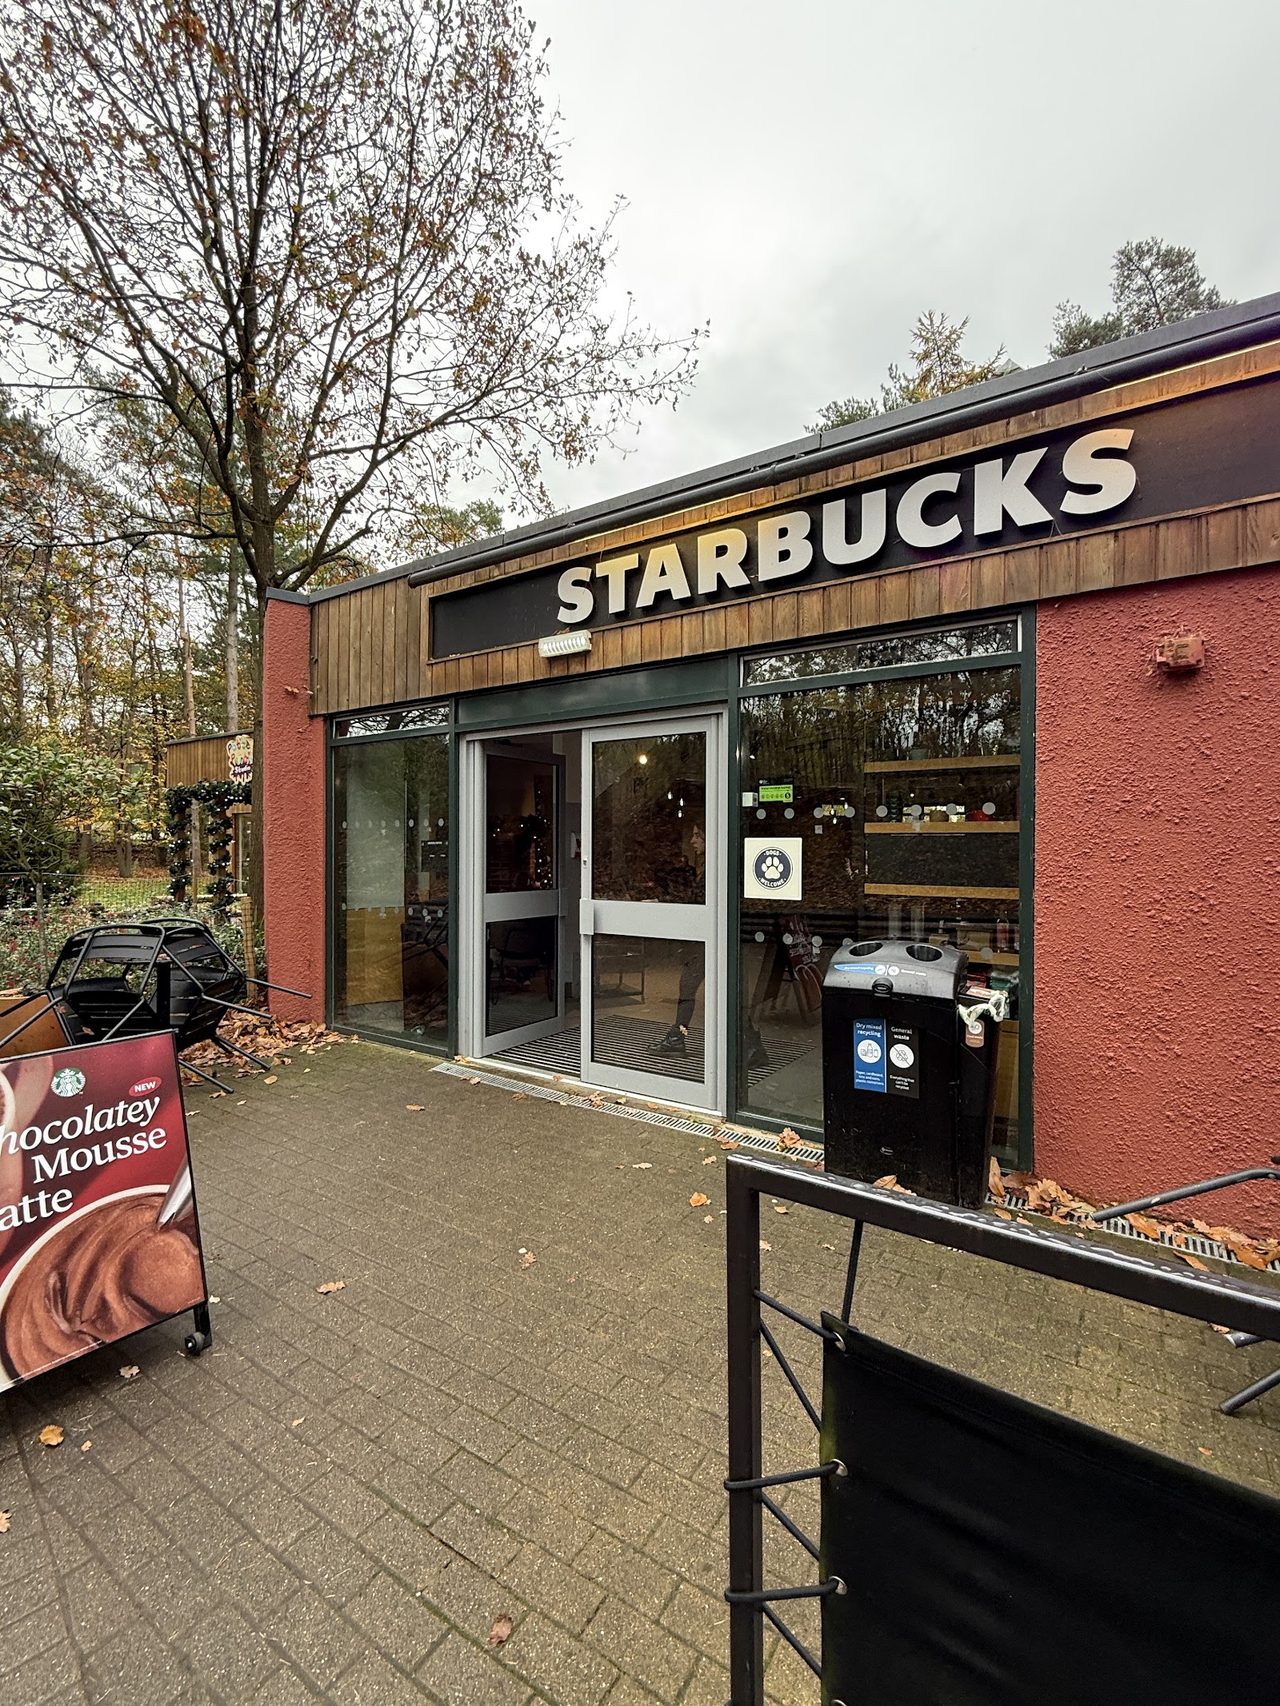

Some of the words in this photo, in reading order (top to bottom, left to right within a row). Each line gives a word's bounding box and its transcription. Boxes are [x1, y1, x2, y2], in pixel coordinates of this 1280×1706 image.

[556, 428, 1137, 624] STARBUCKS
[760, 877, 784, 887] WELCOME
[857, 1030, 881, 1038] recycling
[891, 1026, 912, 1034] General
[134, 1081, 157, 1093] NEW
[31, 1127, 167, 1184] Mousse
[0, 1188, 74, 1232] atte
